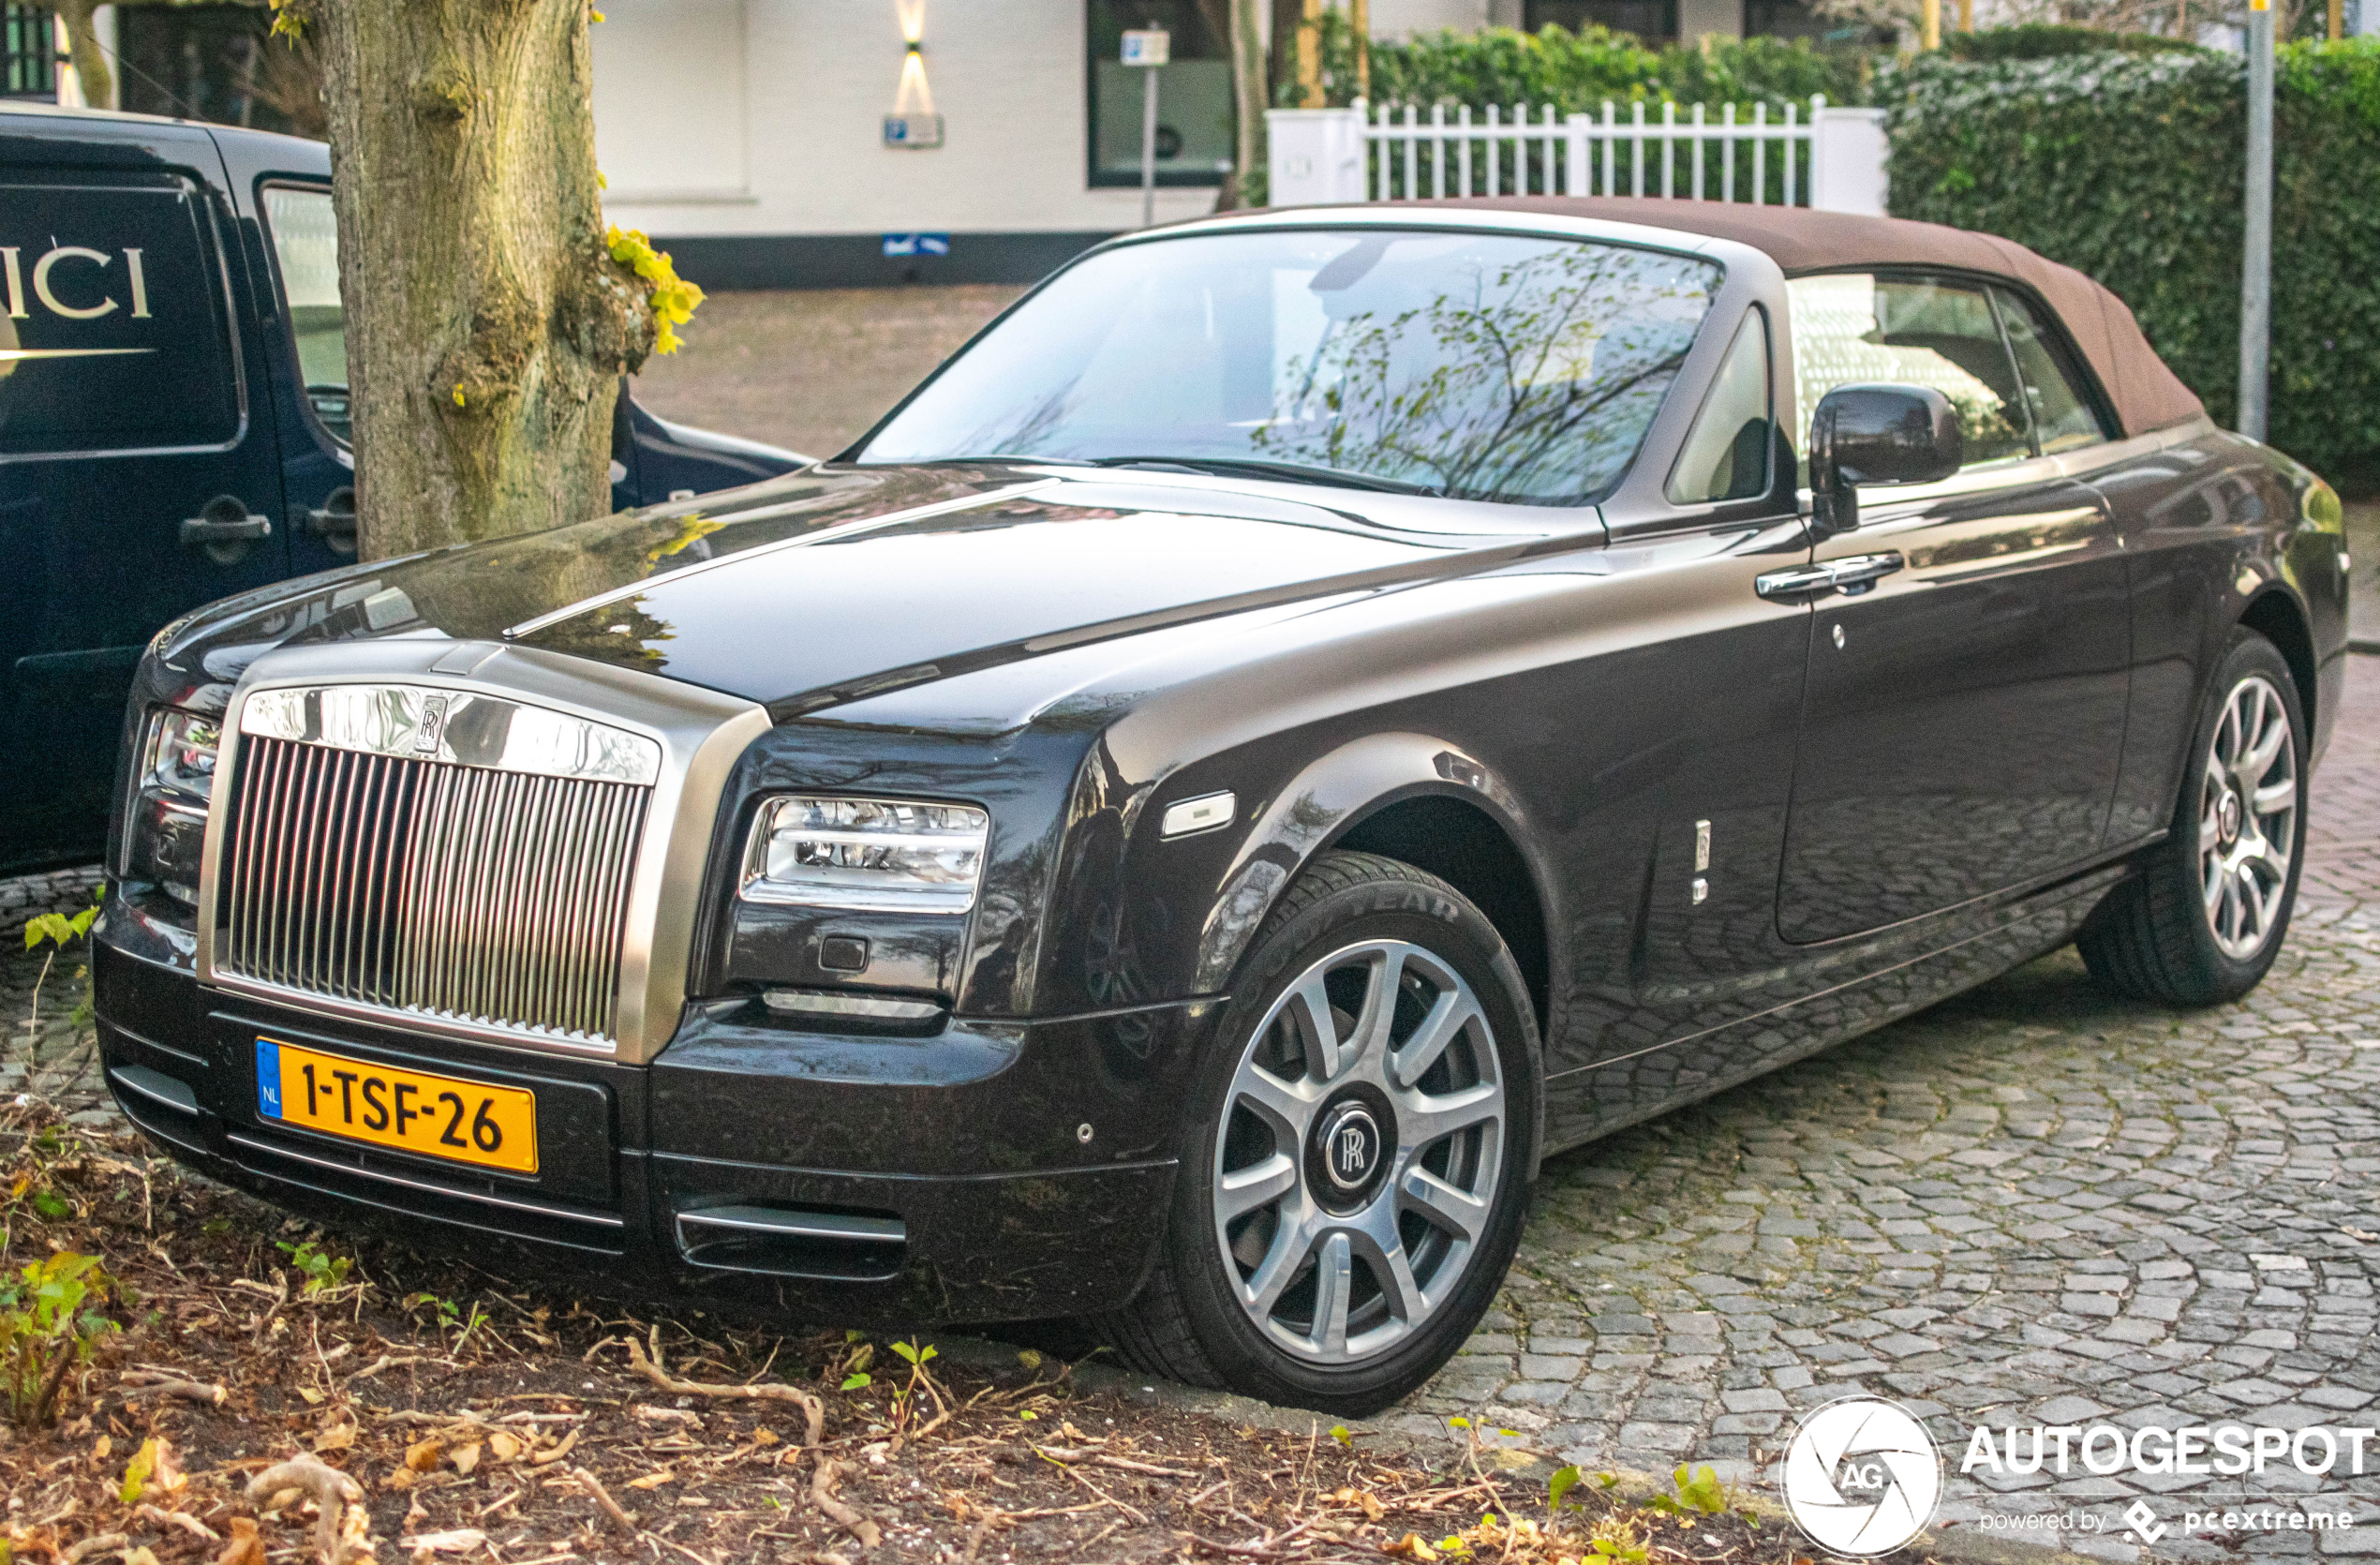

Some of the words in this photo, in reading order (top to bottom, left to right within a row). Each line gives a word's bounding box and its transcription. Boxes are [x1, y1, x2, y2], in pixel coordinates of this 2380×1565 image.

[262, 1084, 279, 1105] NL
[302, 1063, 503, 1153] 1-TSF-26
[1342, 1127, 1365, 1172] RR
